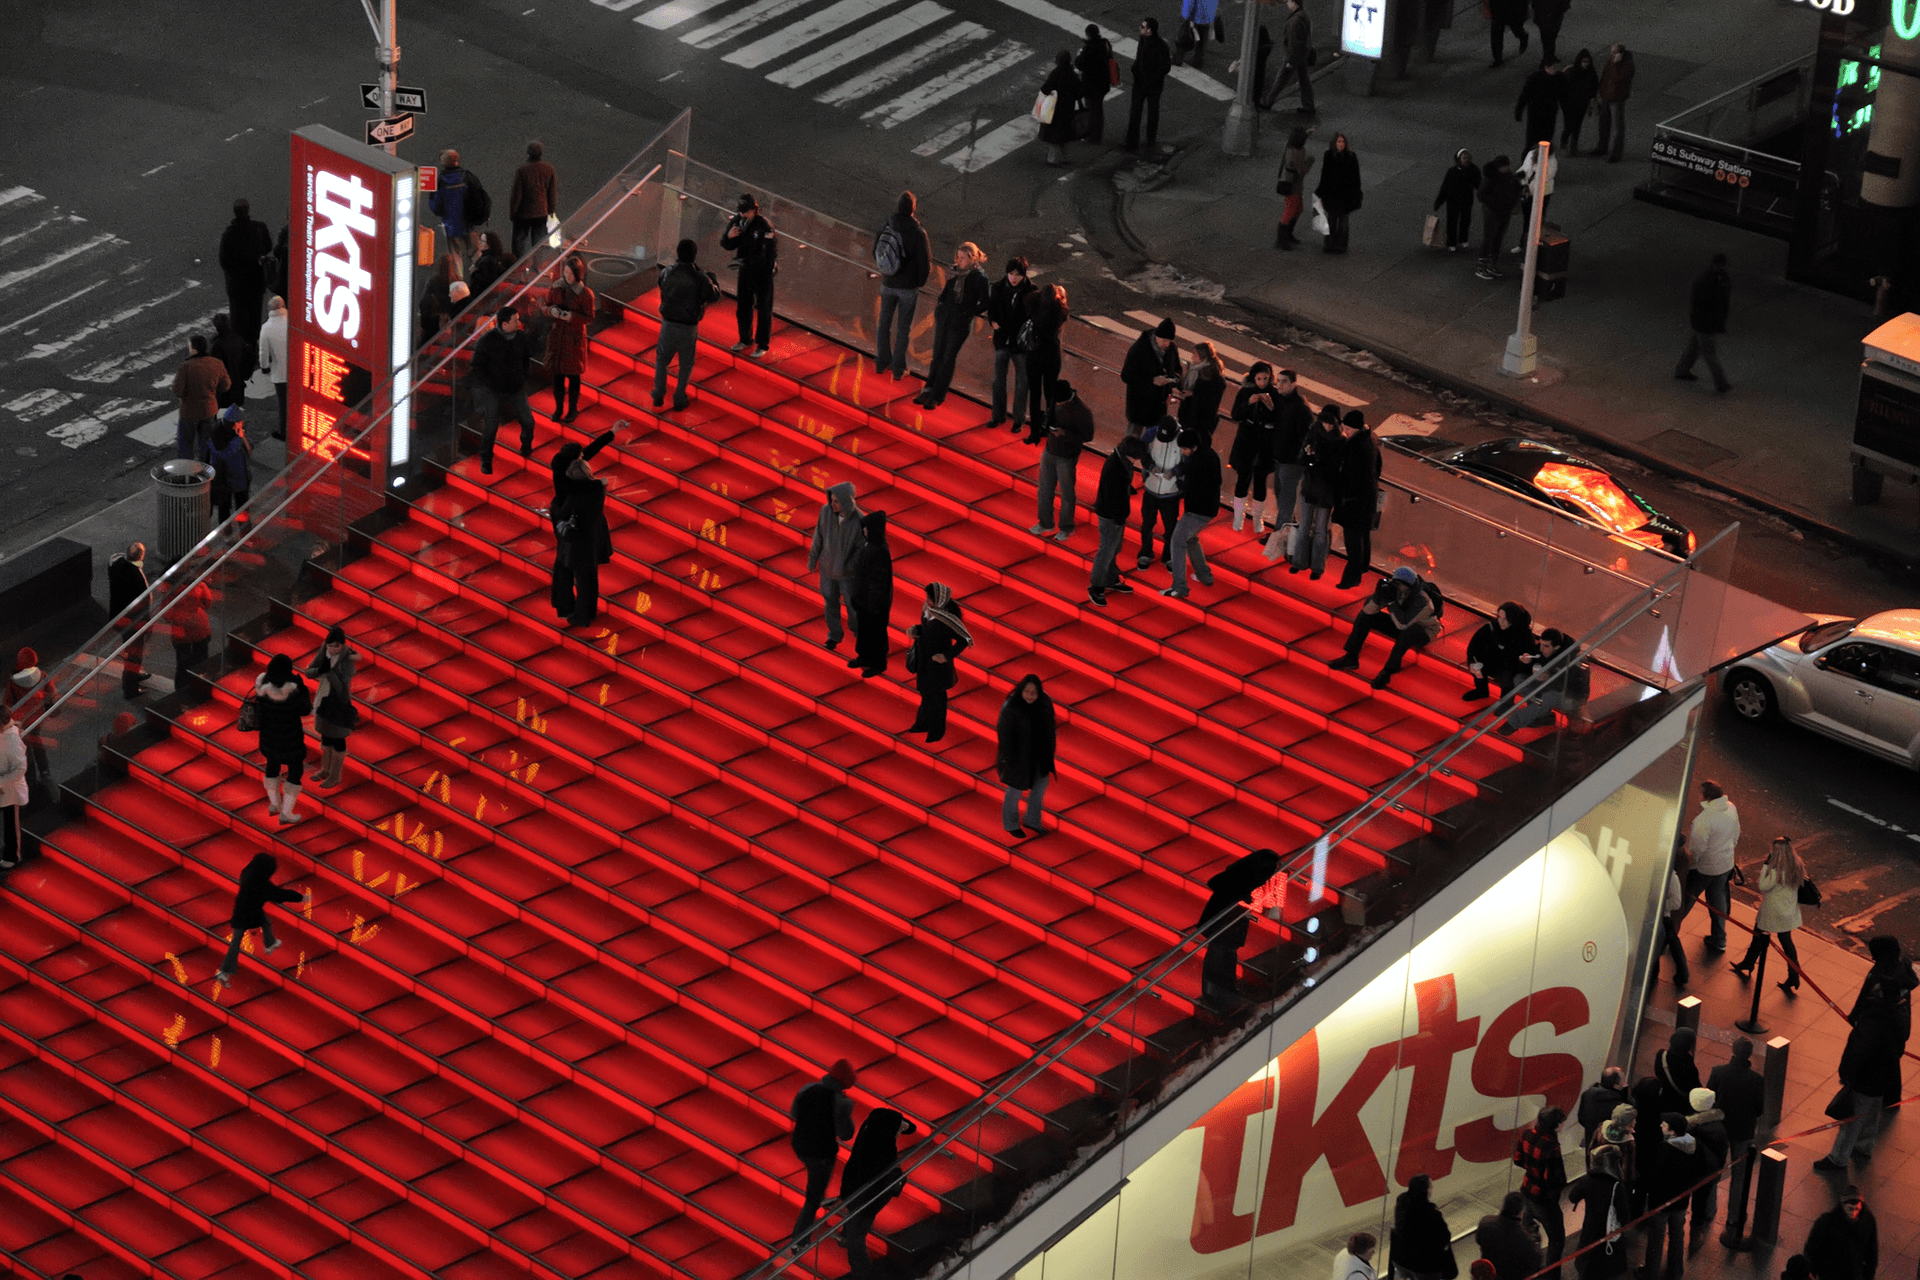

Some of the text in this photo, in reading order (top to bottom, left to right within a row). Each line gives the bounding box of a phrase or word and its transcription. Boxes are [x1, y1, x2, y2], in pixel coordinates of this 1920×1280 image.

[376, 126, 396, 137] ONE
[1651, 152, 1687, 167] Downtown
[1653, 142, 1752, 177] 49 St Subway Station
[306, 172, 314, 203] service
[306, 204, 314, 214] of
[306, 215, 314, 246] Theatre
[313, 170, 377, 340] tkts
[304, 247, 313, 300] Development
[304, 301, 313, 323] Fund
[1187, 972, 1590, 1255] tkts
